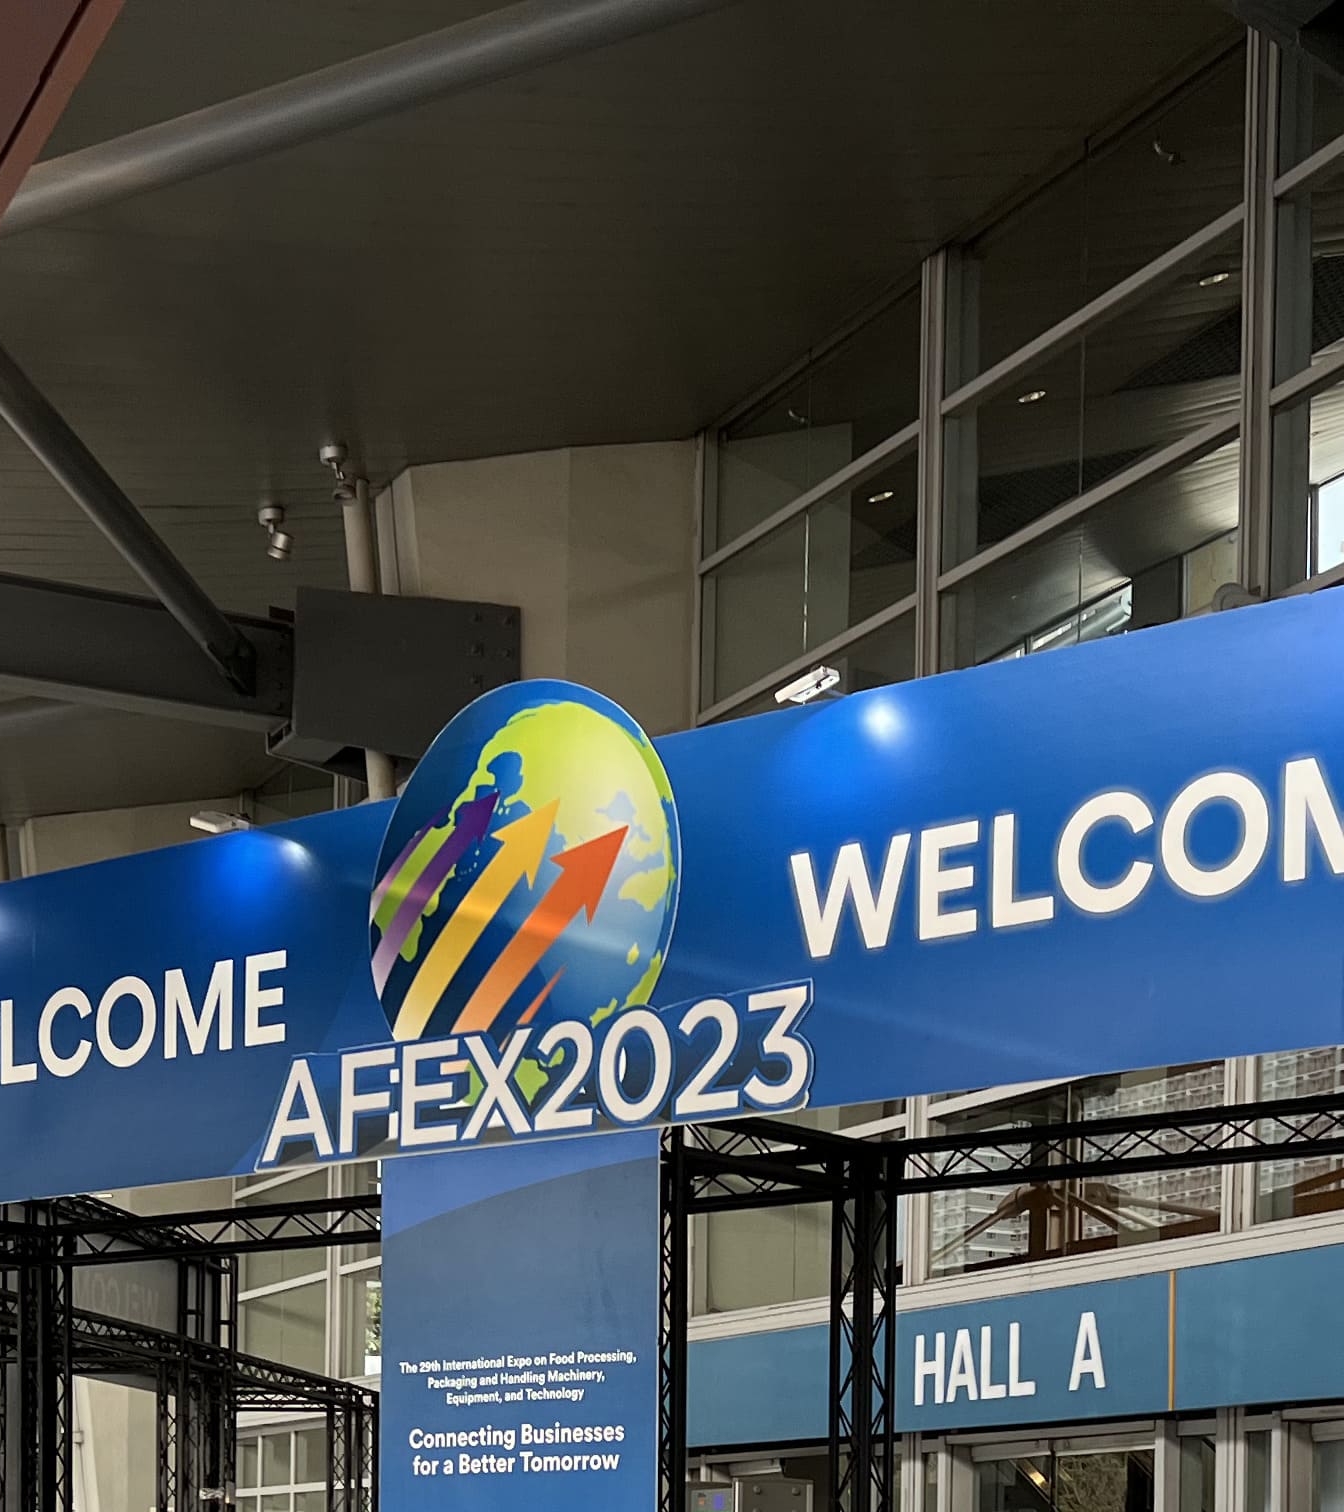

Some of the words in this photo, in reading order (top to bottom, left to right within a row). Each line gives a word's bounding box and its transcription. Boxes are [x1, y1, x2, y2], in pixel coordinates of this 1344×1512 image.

[261, 980, 812, 1165] AFEX2023
[400, 1361, 417, 1374] The
[419, 1360, 440, 1373] 29th
[442, 1356, 505, 1371] International
[507, 1354, 532, 1370] Expo
[534, 1357, 547, 1366] on
[549, 1352, 574, 1365] Food
[577, 1349, 637, 1365] Processing,
[914, 1322, 1036, 1406] HALL
[1068, 1312, 1106, 1391] A
[427, 1375, 477, 1389] Packaging
[479, 1374, 499, 1386] and
[500, 1371, 545, 1386] Handling
[547, 1369, 605, 1384] Machinery,
[446, 1391, 502, 1406] Equipment,
[504, 1390, 524, 1401] and
[525, 1387, 584, 1402] Technology
[409, 1424, 515, 1450] Connecting
[520, 1422, 625, 1445] Businesses
[413, 1455, 439, 1476] for
[443, 1461, 454, 1475] a
[458, 1452, 516, 1474] Better
[519, 1450, 620, 1472] Tomorrow
